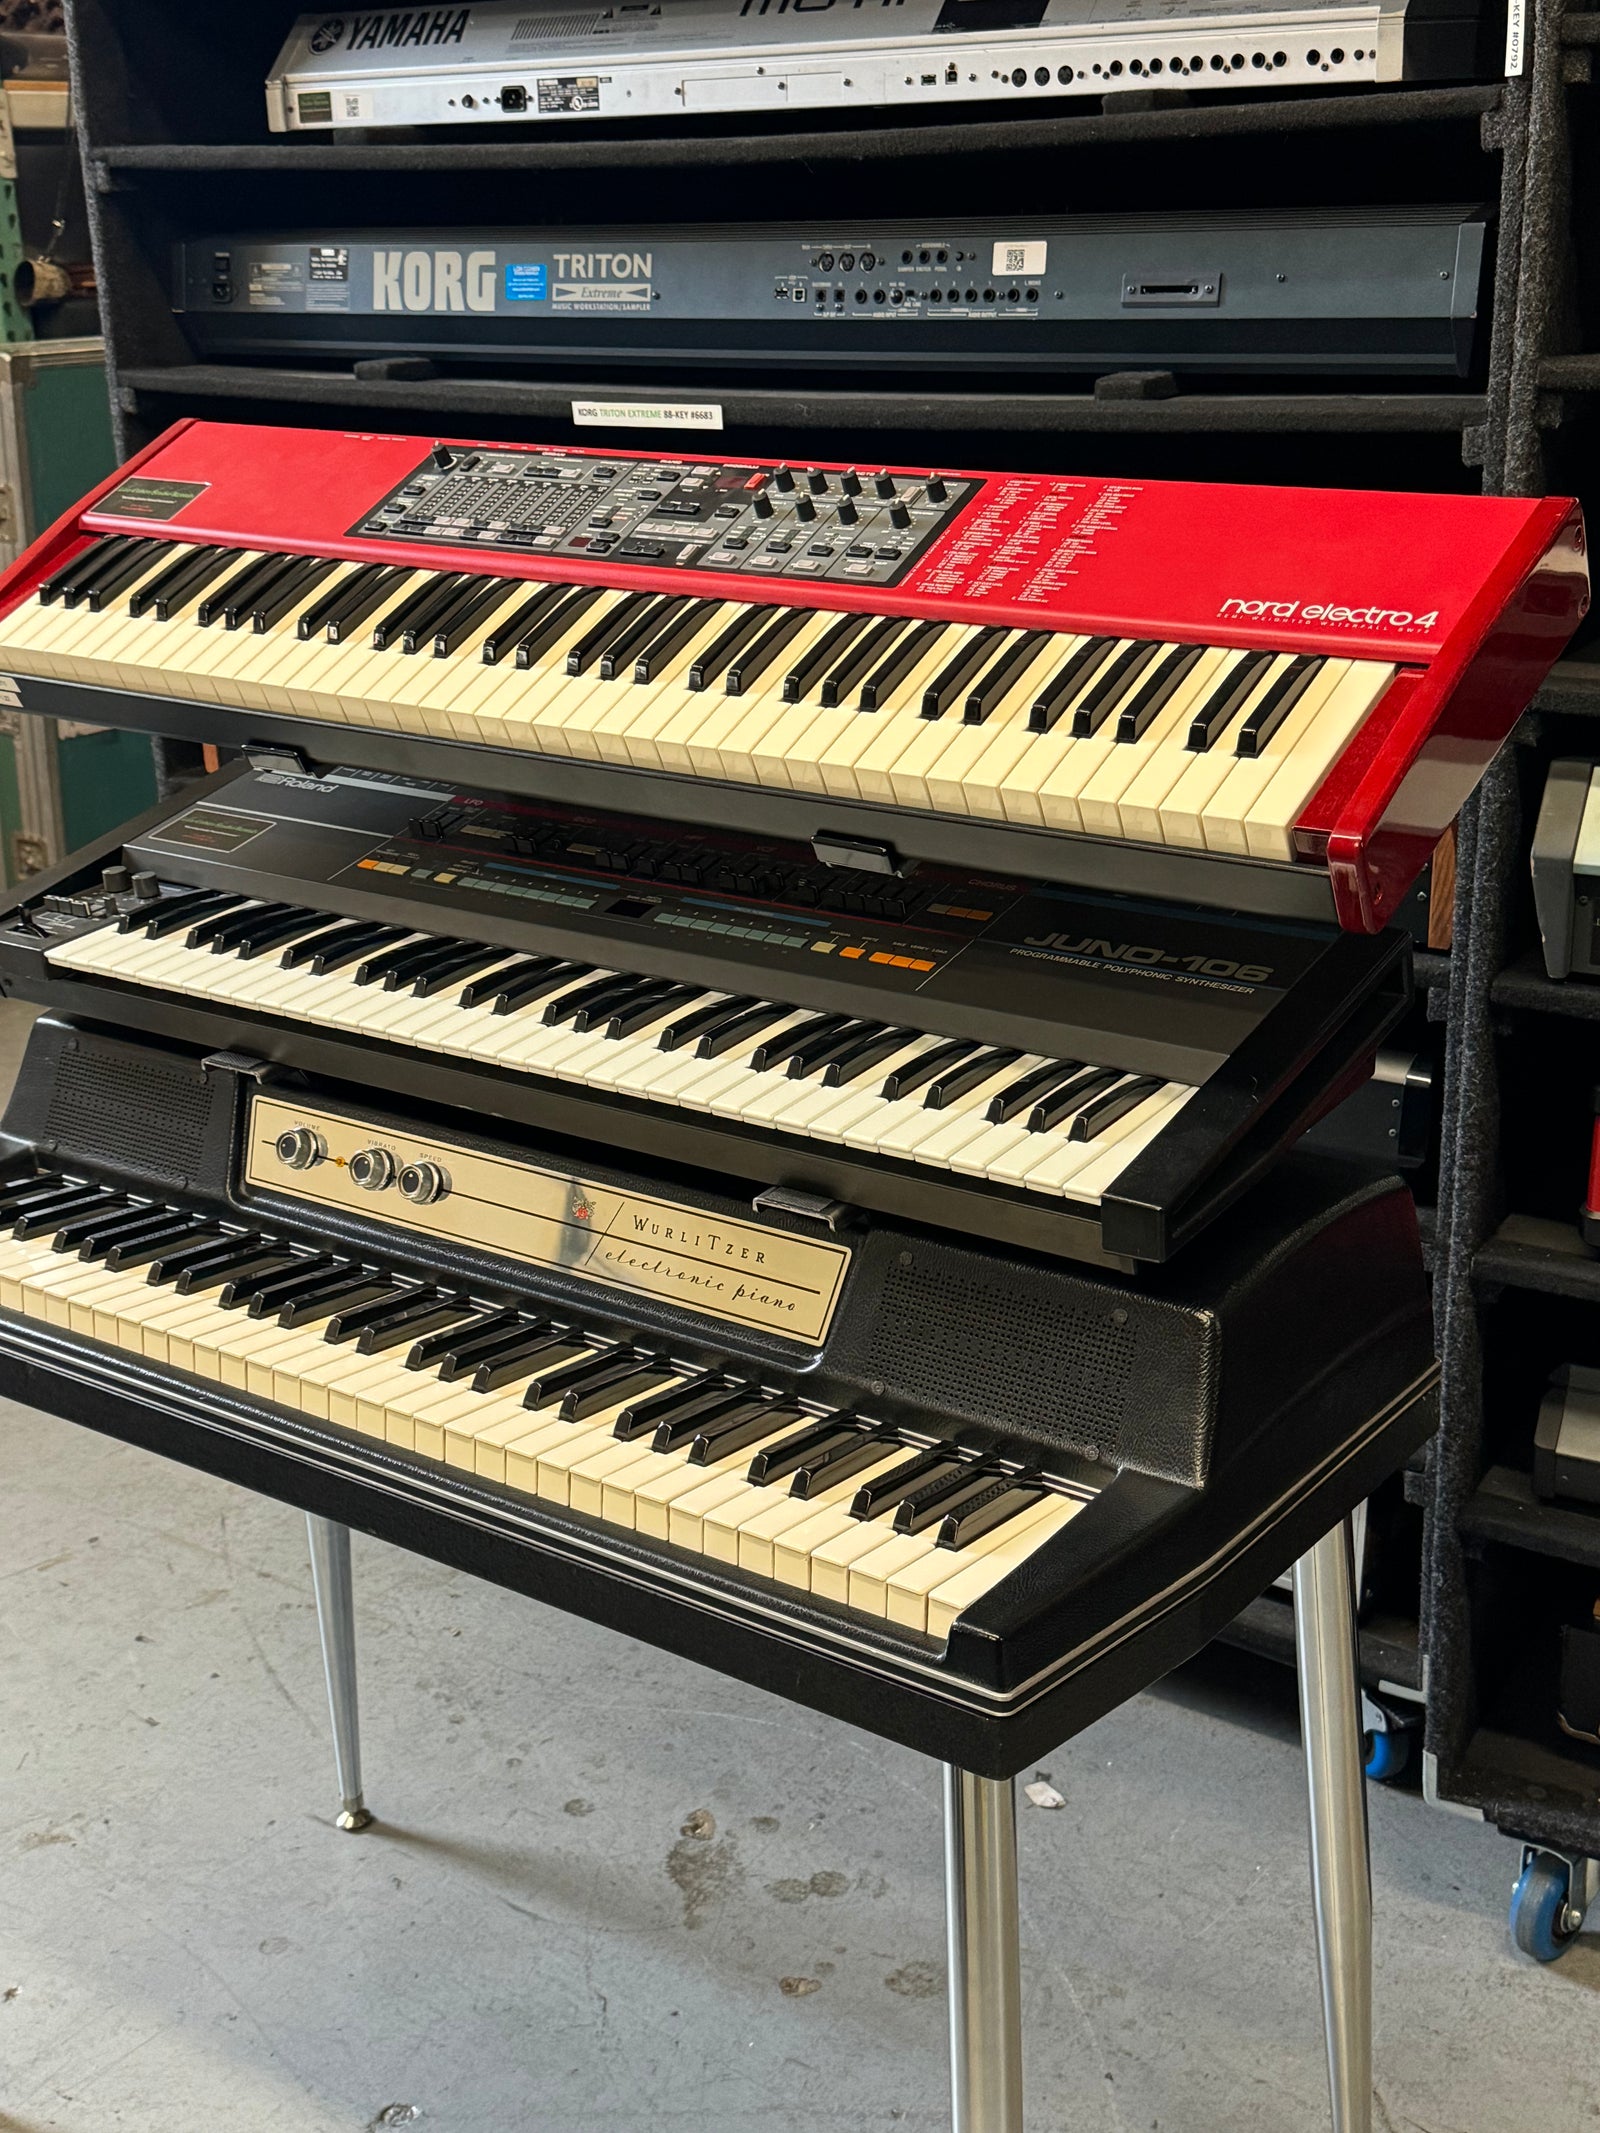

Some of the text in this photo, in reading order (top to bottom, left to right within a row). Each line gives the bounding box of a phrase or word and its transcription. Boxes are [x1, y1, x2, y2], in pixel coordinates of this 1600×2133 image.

[346, 9, 471, 50] YAMAHA
[553, 253, 652, 278] TRITON
[373, 251, 497, 311] KORG
[580, 286, 623, 299] Extreme
[552, 302, 650, 311] MUSIC WORKSTATION/SAMPLER
[578, 408, 598, 417] KORG
[600, 409, 626, 418] TRITON
[628, 410, 662, 419] EXTREME
[664, 411, 689, 419] 88-KEY
[1219, 598, 1300, 617] nord
[1320, 621, 1388, 631] WATERFALL
[279, 776, 339, 793] Roland
[1024, 932, 1274, 983] JUNO-106
[1009, 948, 1255, 994] PROGRAMMABLE POLYPHONIC SYNTHESIZER
[294, 1120, 320, 1131] VOLUME
[367, 1138, 396, 1151] VIBRATO
[419, 1152, 442, 1163] SPEED
[605, 1249, 796, 1311] electronic piano
